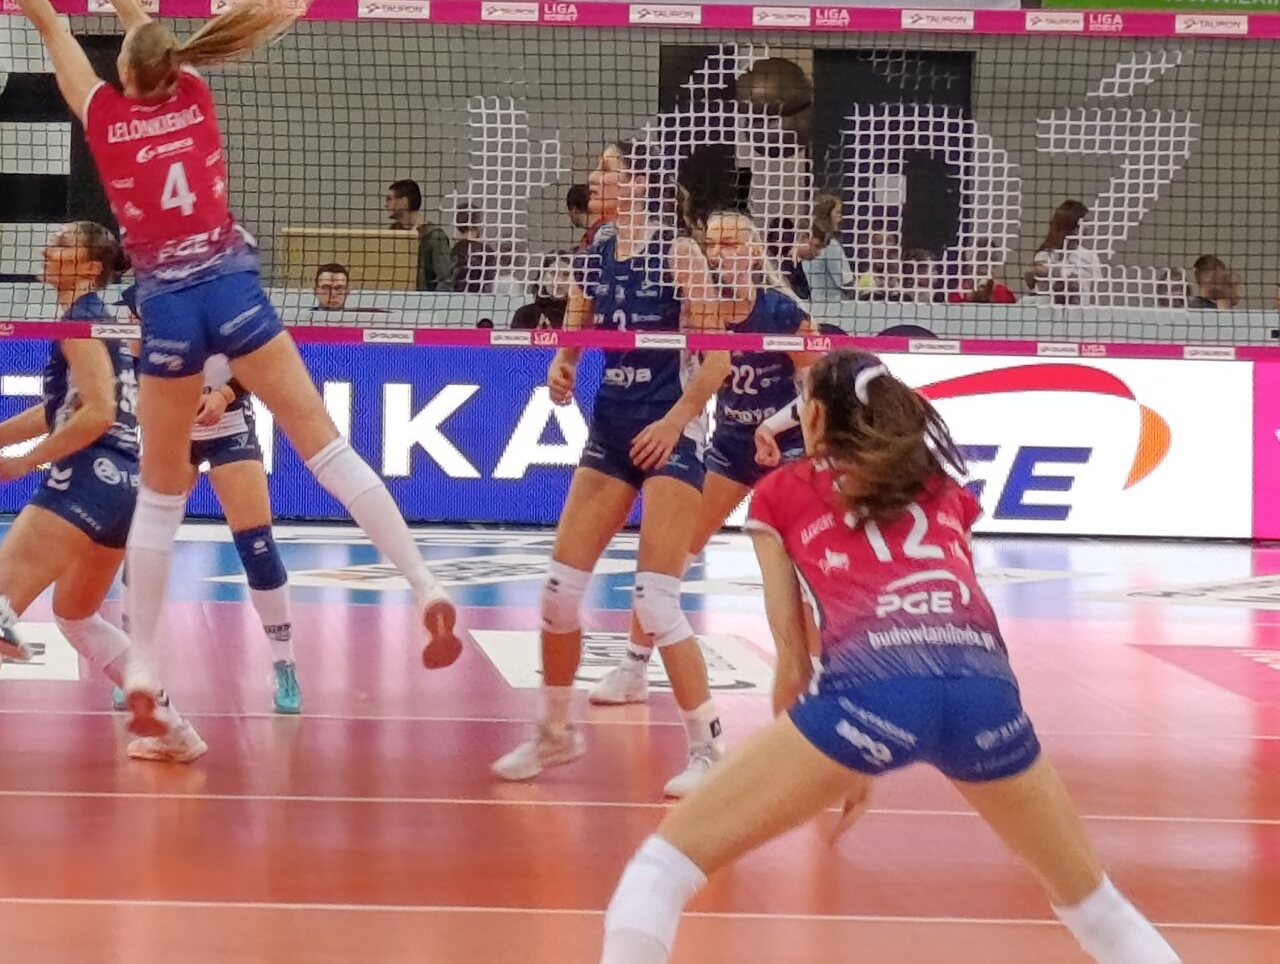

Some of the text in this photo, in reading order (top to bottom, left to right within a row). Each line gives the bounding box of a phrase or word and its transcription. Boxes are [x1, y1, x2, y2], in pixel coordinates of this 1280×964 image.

[543, 4, 578, 14] LIGA
[815, 8, 850, 19] LIGA
[1089, 14, 1123, 25] LIGA
[160, 161, 198, 217] 4
[730, 364, 759, 395] 22
[842, 502, 945, 564] 12
[876, 590, 954, 618] PGE
